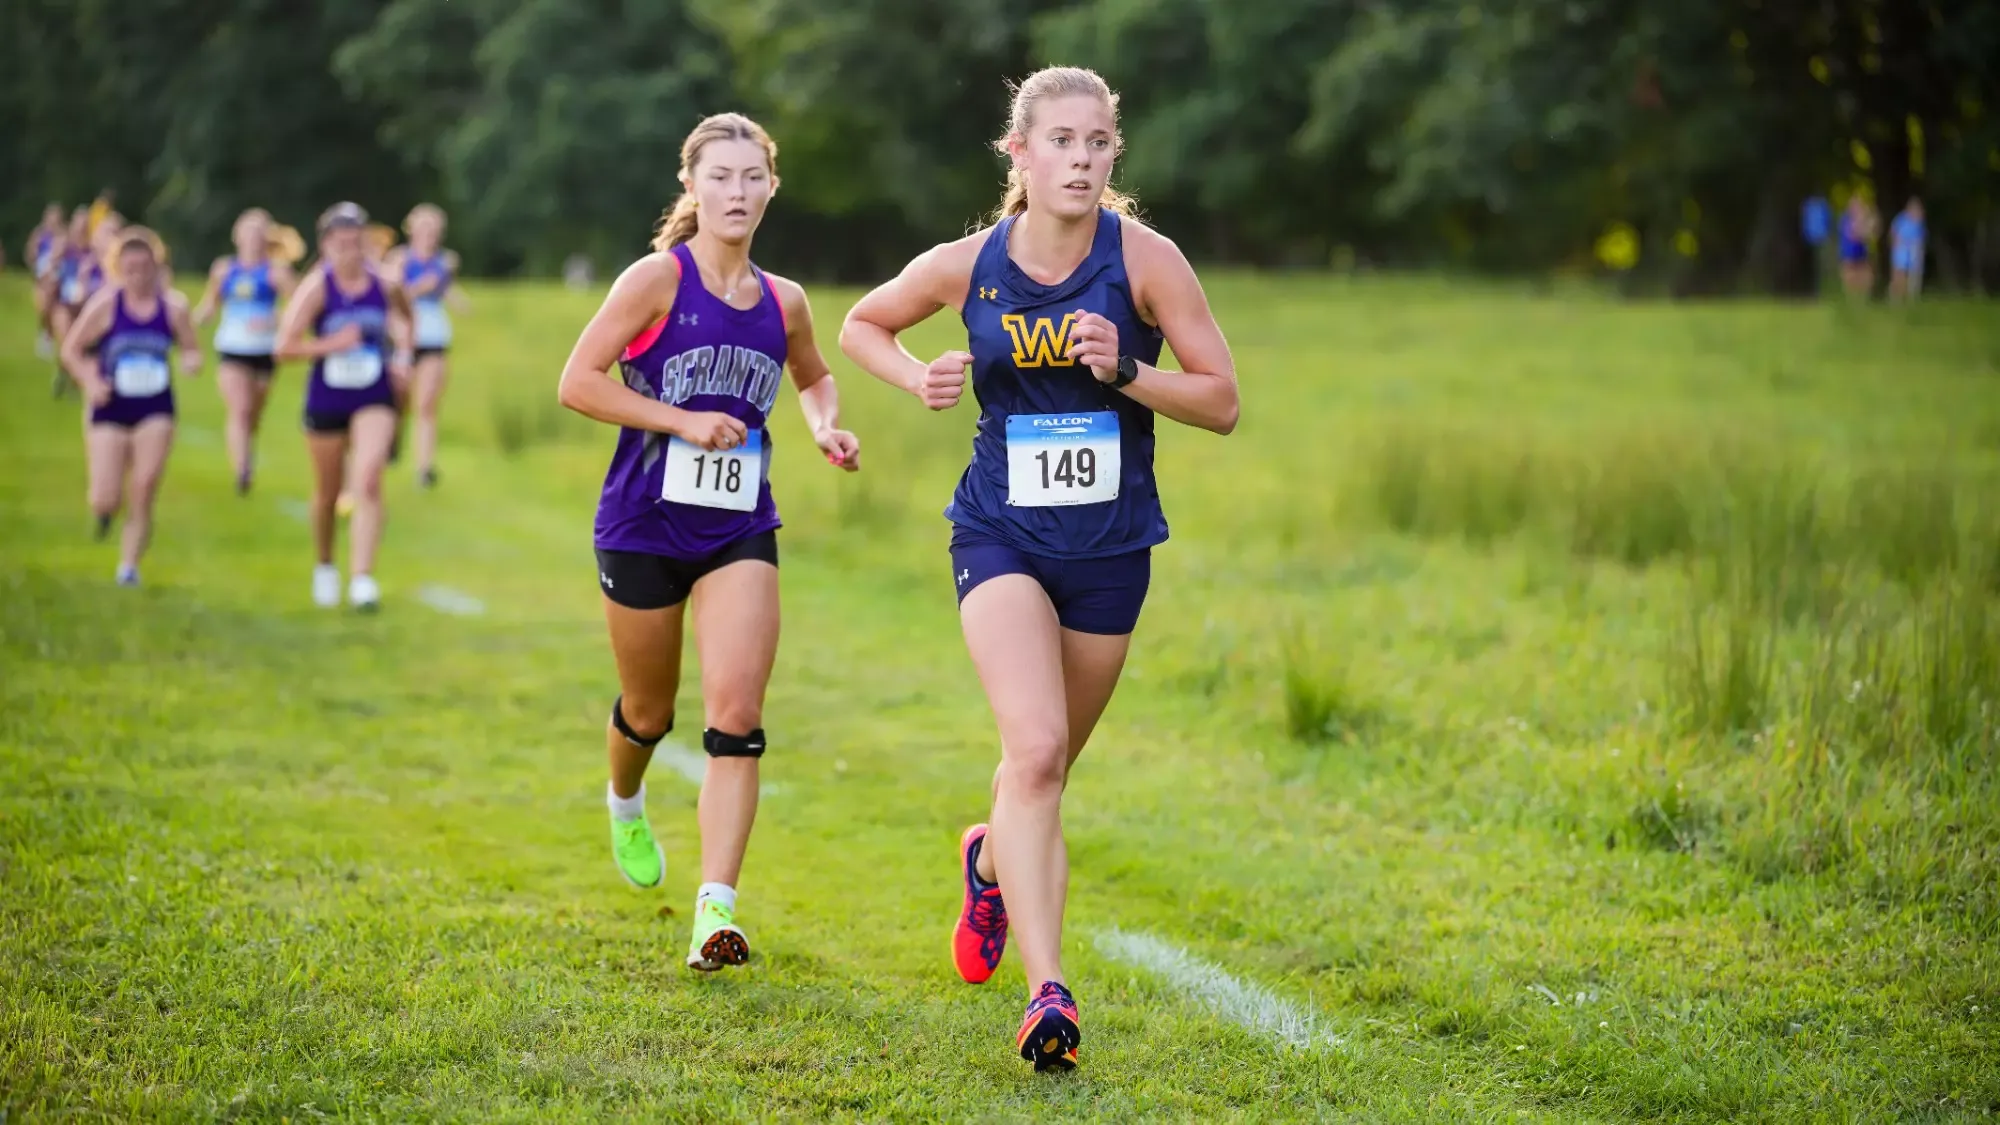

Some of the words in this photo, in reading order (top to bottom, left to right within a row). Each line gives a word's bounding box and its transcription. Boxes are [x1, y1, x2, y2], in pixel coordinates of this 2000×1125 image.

[1001, 313, 1080, 368] W
[660, 344, 782, 418] SCRANTO
[1033, 416, 1093, 426] FALCON
[693, 454, 742, 493] 118
[1035, 447, 1096, 489] 149
